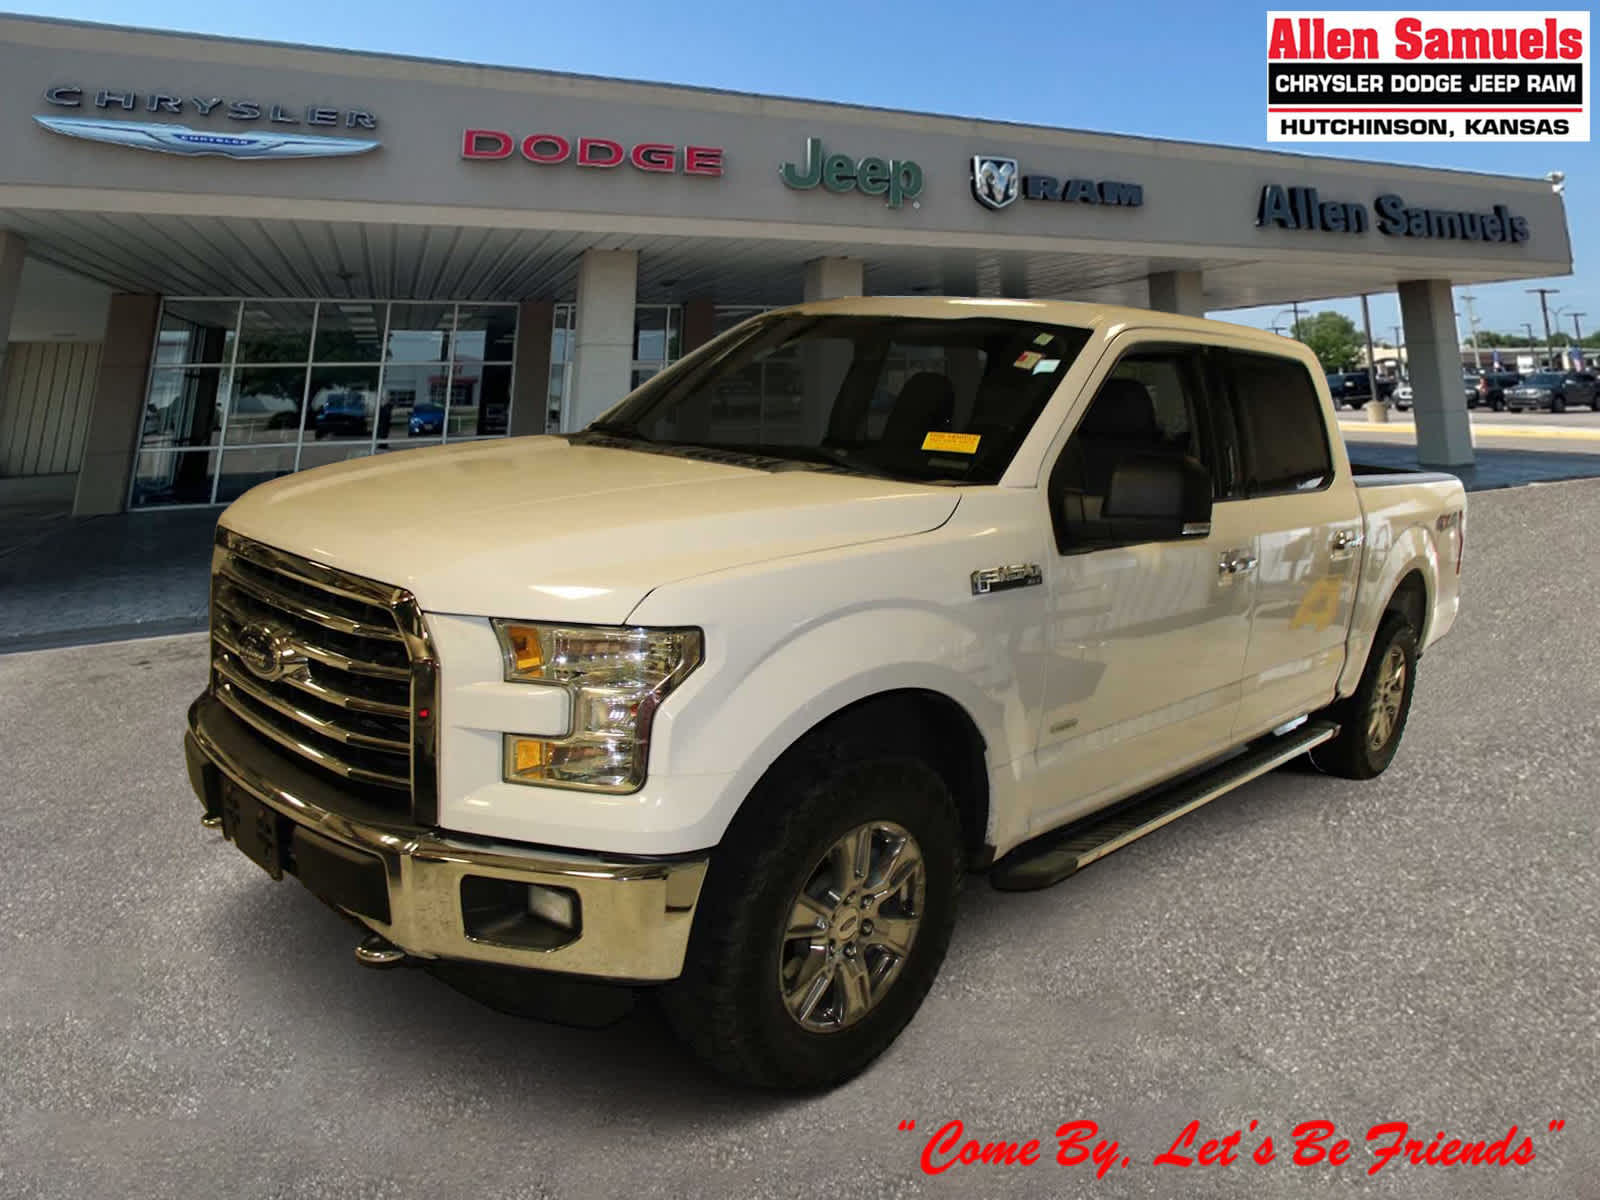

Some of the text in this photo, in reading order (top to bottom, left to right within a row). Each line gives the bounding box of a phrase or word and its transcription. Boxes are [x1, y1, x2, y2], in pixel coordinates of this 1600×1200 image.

[43, 86, 378, 129] CHRYSLER
[461, 128, 724, 178] DODGE
[779, 137, 924, 209] Jeep
[1022, 175, 1144, 207] RAM
[1254, 184, 1530, 243] Allen Samuels
